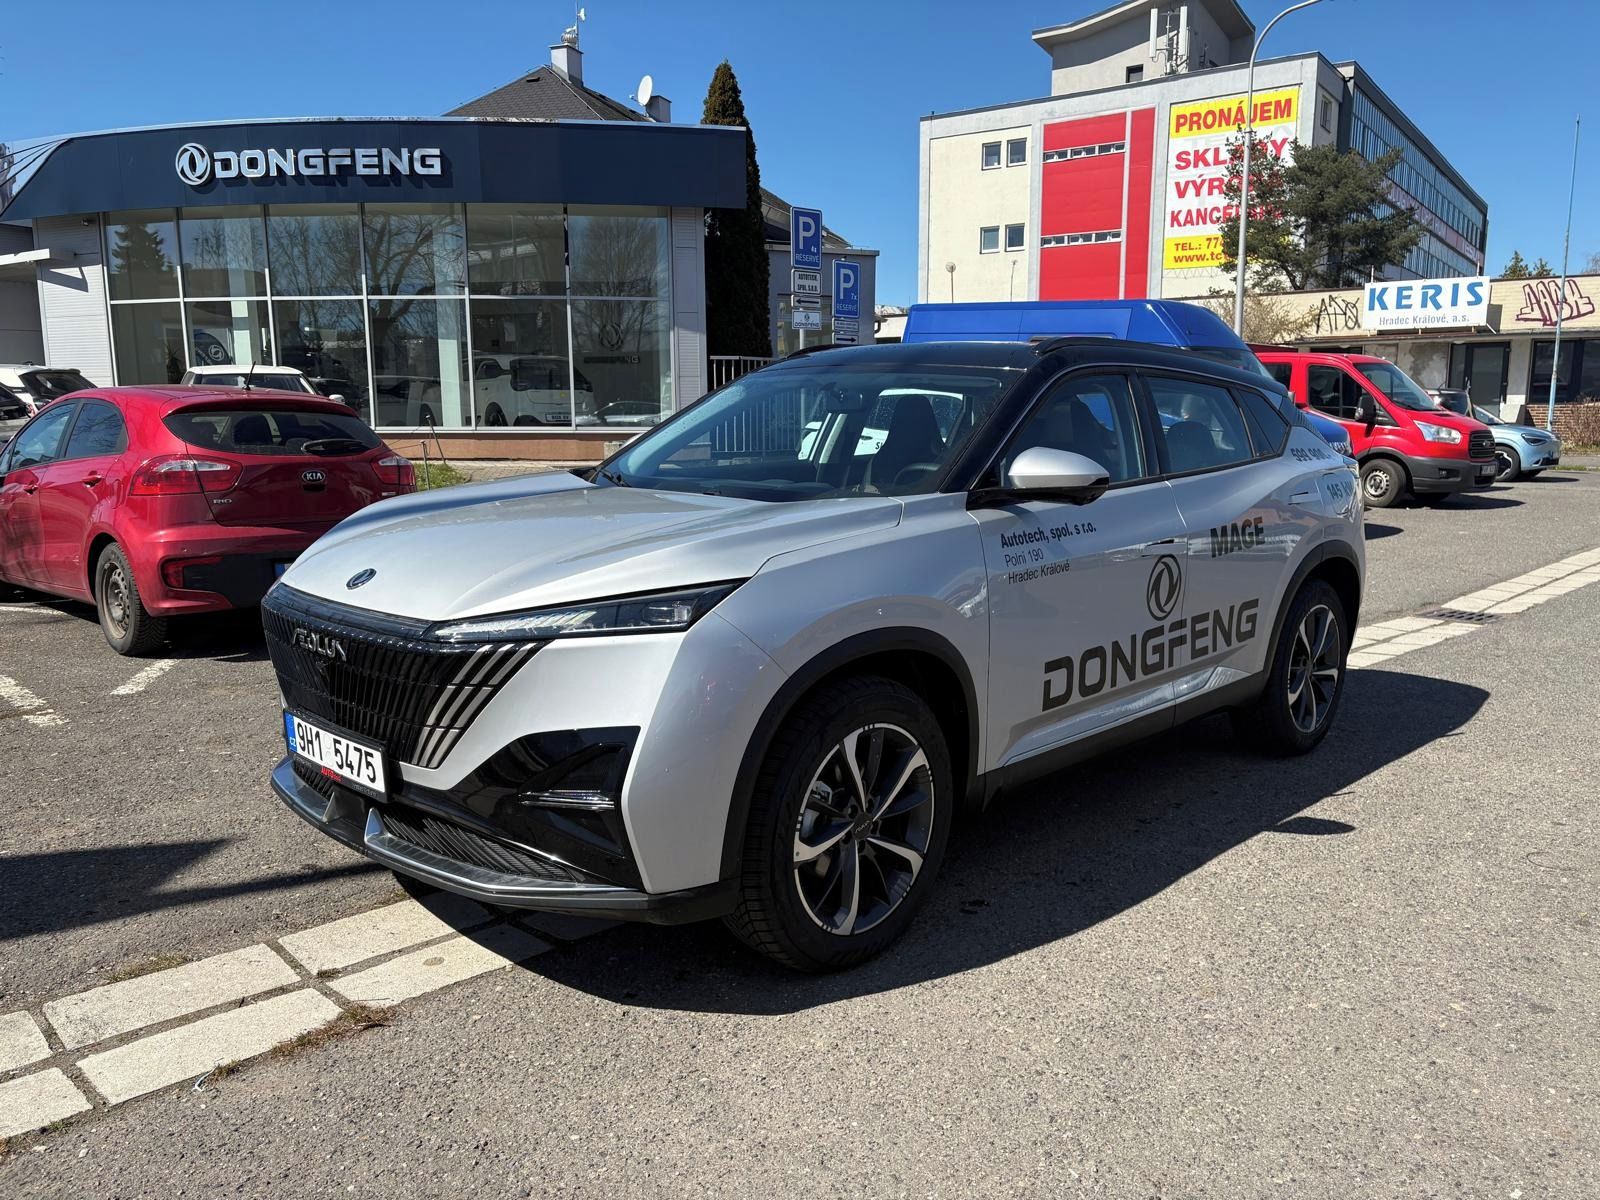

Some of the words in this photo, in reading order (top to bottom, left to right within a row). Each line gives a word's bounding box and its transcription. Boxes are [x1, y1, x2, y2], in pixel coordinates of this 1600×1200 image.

[1175, 98, 1293, 133] PRONÁJEM
[213, 148, 442, 179] DONGFENG
[799, 216, 816, 250] P
[1174, 242, 1202, 251] TEL.:
[840, 268, 855, 300] P
[1368, 281, 1484, 312] KERIS
[1379, 316, 1410, 326] Hradec
[306, 472, 323, 481] KIA
[1326, 483, 1343, 501] 145
[1001, 527, 1050, 549] Autotech,
[1050, 522, 1073, 542] spol.
[1074, 524, 1081, 535] s
[1210, 517, 1266, 558] MAGE
[1004, 550, 1027, 568] Polní
[1028, 547, 1045, 563] 190
[1008, 568, 1039, 585] Hradec
[1040, 559, 1070, 577] Králové
[1042, 598, 1260, 712] DONGFENG
[296, 722, 323, 761] 9H1
[333, 738, 377, 784] 5475
